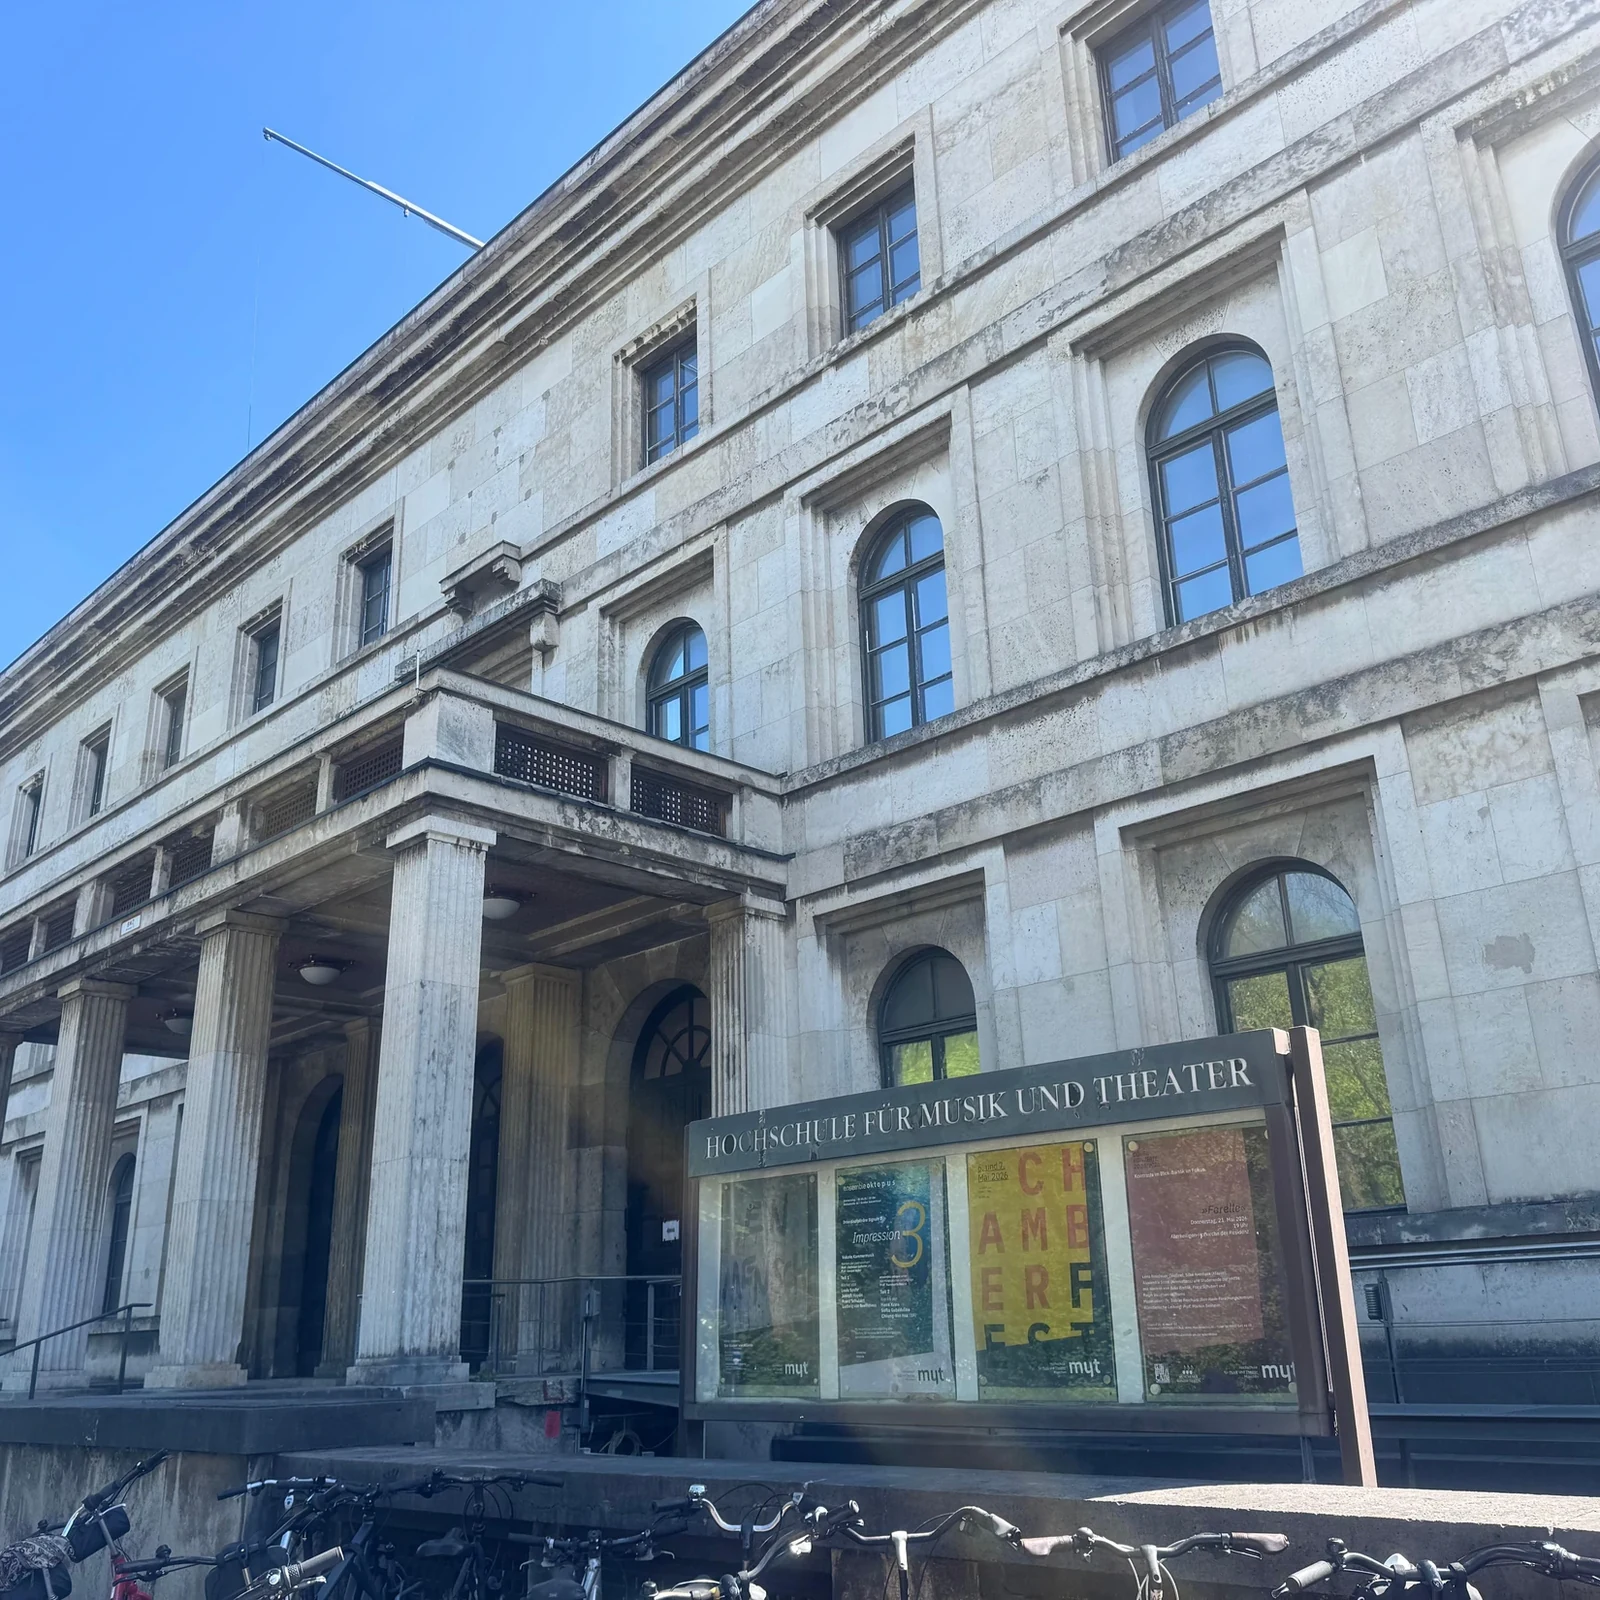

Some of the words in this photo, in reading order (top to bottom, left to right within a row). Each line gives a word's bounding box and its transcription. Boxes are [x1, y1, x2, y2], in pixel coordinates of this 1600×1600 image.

[705, 1114, 857, 1159] HOCHSCHULE
[863, 1103, 914, 1136] FÜR
[919, 1091, 1008, 1129] MUSIK
[1016, 1081, 1085, 1115] UND
[1092, 1057, 1256, 1104] THEATER
[991, 1171, 1009, 1181] 2026
[852, 1230, 901, 1245] Impression
[891, 1200, 926, 1268] 3
[1069, 1358, 1101, 1377] myt
